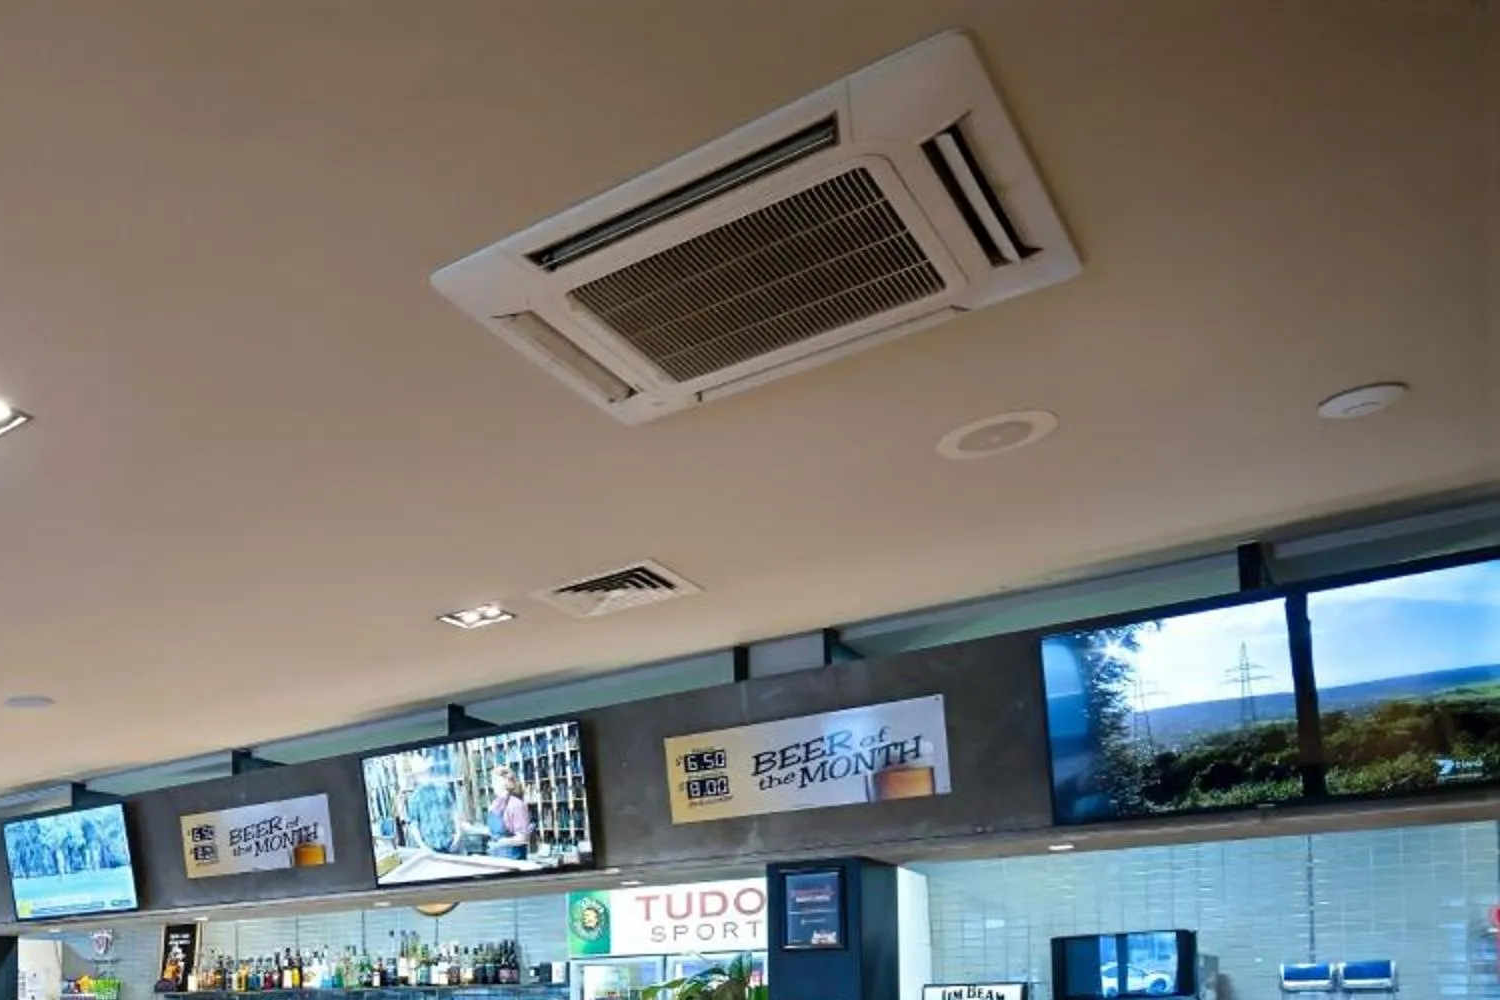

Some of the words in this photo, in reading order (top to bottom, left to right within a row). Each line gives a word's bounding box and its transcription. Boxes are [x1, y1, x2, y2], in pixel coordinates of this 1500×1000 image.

[687, 751, 726, 771] 6.50
[751, 728, 853, 776] BEER
[859, 725, 890, 746] of
[759, 771, 797, 790] the
[798, 735, 923, 789] MONTH
[229, 815, 282, 846] BEER
[254, 821, 319, 857] MONTH
[635, 887, 766, 922] TUDO
[650, 919, 762, 943] SPORT
